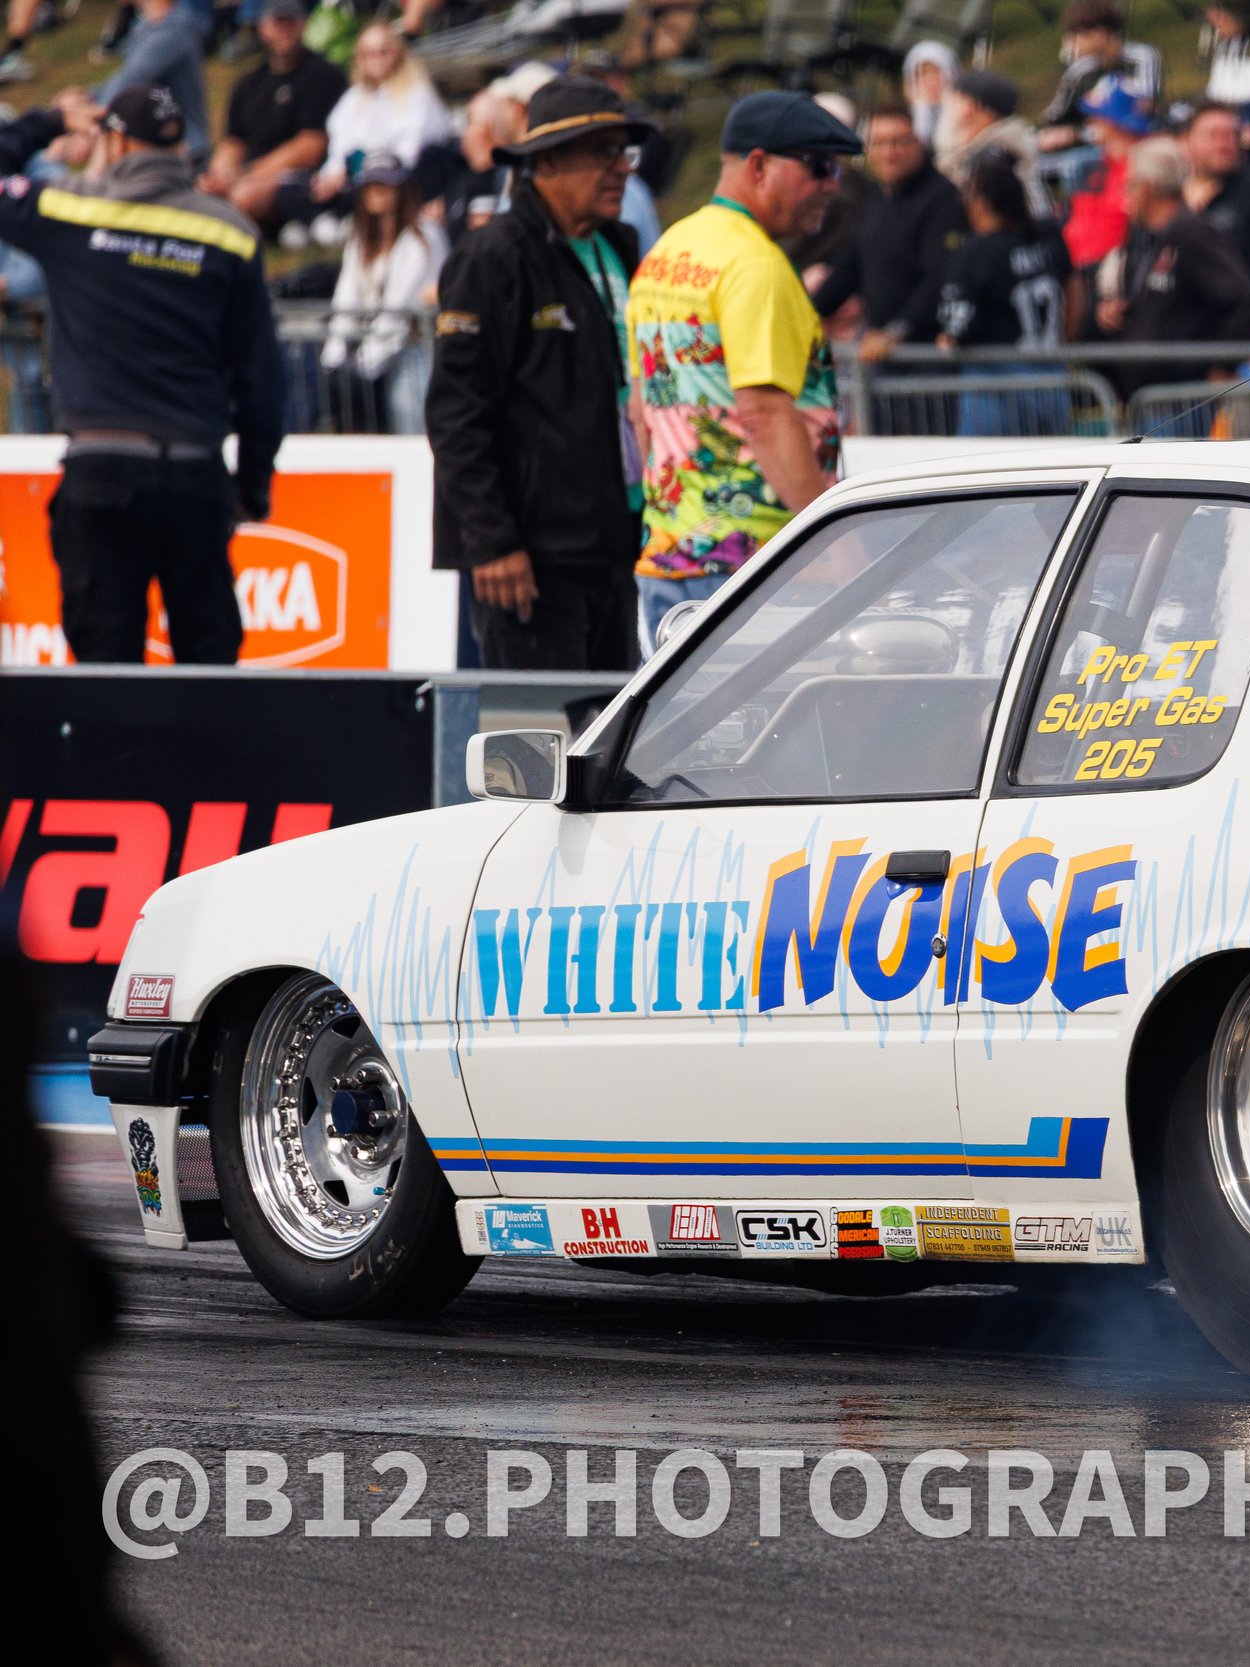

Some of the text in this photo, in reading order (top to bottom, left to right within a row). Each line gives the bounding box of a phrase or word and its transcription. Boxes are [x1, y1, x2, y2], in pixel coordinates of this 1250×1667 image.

[1077, 639, 1219, 685] Pro ET
[1036, 686, 1229, 739] Super Gas
[1073, 737, 1164, 781] 205
[473, 836, 1139, 1017] WHITE NOISE
[129, 977, 172, 1000] Huxley
[506, 1210, 543, 1222] Maverick
[581, 1207, 622, 1239] BH
[925, 1207, 999, 1220] INDEPENDENT
[741, 1217, 822, 1241] CSK
[926, 1226, 1003, 1241] SCAFFOLDING
[1014, 1217, 1093, 1243] GTM
[1098, 1217, 1132, 1247] UK
[563, 1240, 649, 1256] CONSTRUCTION
[755, 1241, 814, 1251] BUILDING LTD
[884, 1237, 916, 1245] UPHOLSTERY
[1046, 1243, 1090, 1252] RACING
